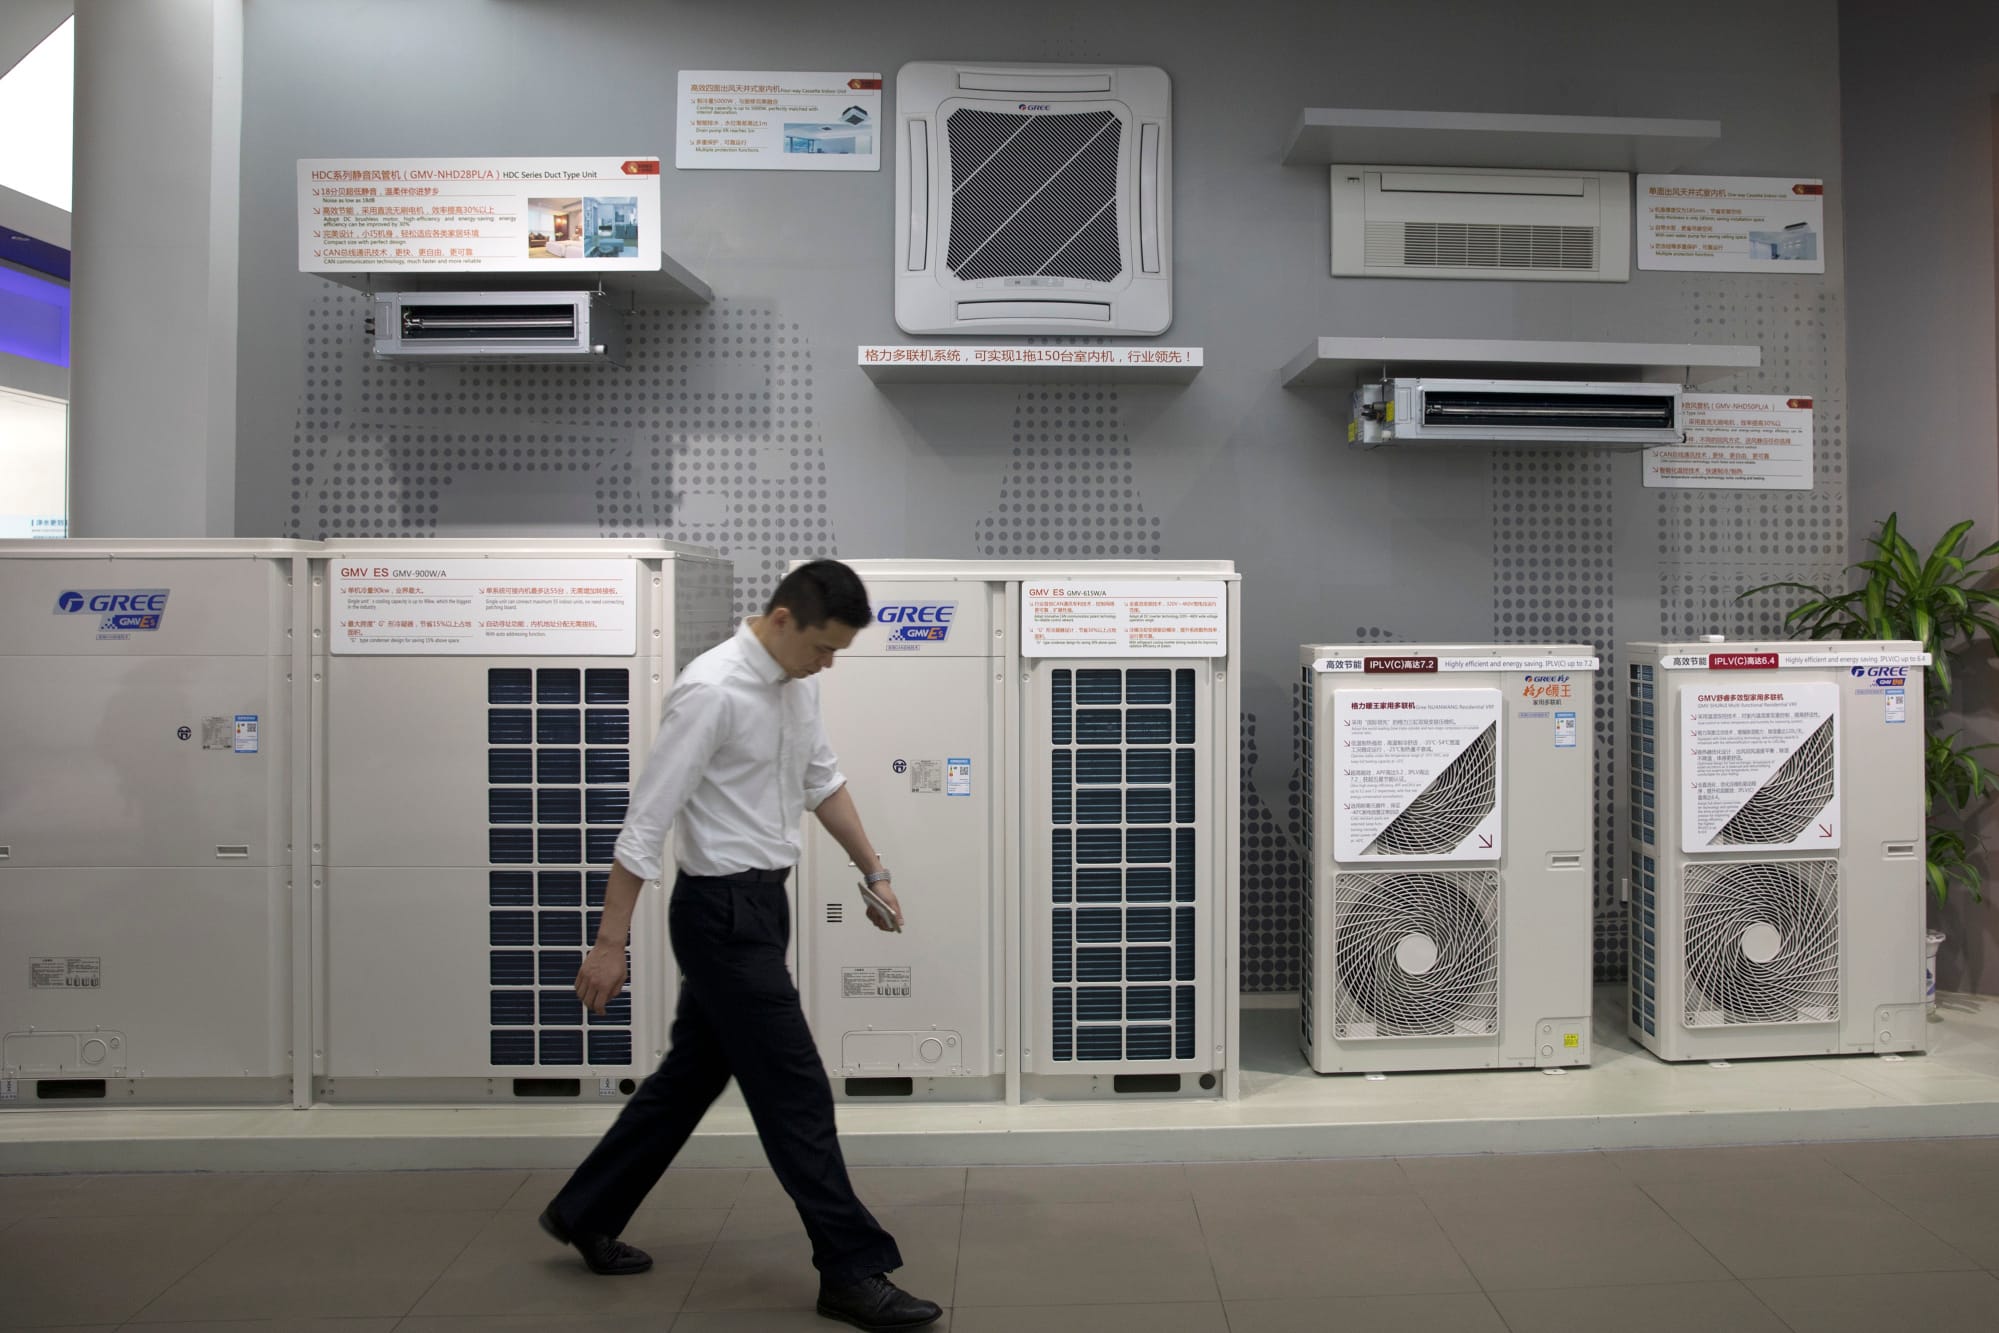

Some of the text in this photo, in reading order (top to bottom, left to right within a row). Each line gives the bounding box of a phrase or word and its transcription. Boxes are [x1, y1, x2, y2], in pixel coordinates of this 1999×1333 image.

[521, 171, 542, 179] Series
[544, 171, 561, 179] Duct
[563, 171, 581, 180] Type
[582, 171, 597, 179] Unit
[865, 349, 1192, 363] 格力多联机系统，可实现1拖150台室内机，行业领先！
[341, 568, 447, 578] GMV ES GMV-900W/A
[89, 594, 167, 612] GREE
[877, 606, 954, 623] GREE
[1326, 660, 1434, 670] 高效节能 IPLV(C)高达7.2
[1673, 656, 1775, 666] 高效节能 IPLV(C)高达6.4
[1867, 666, 1910, 677] GREE
[1351, 702, 1416, 710] 格力暖王家用多联机
